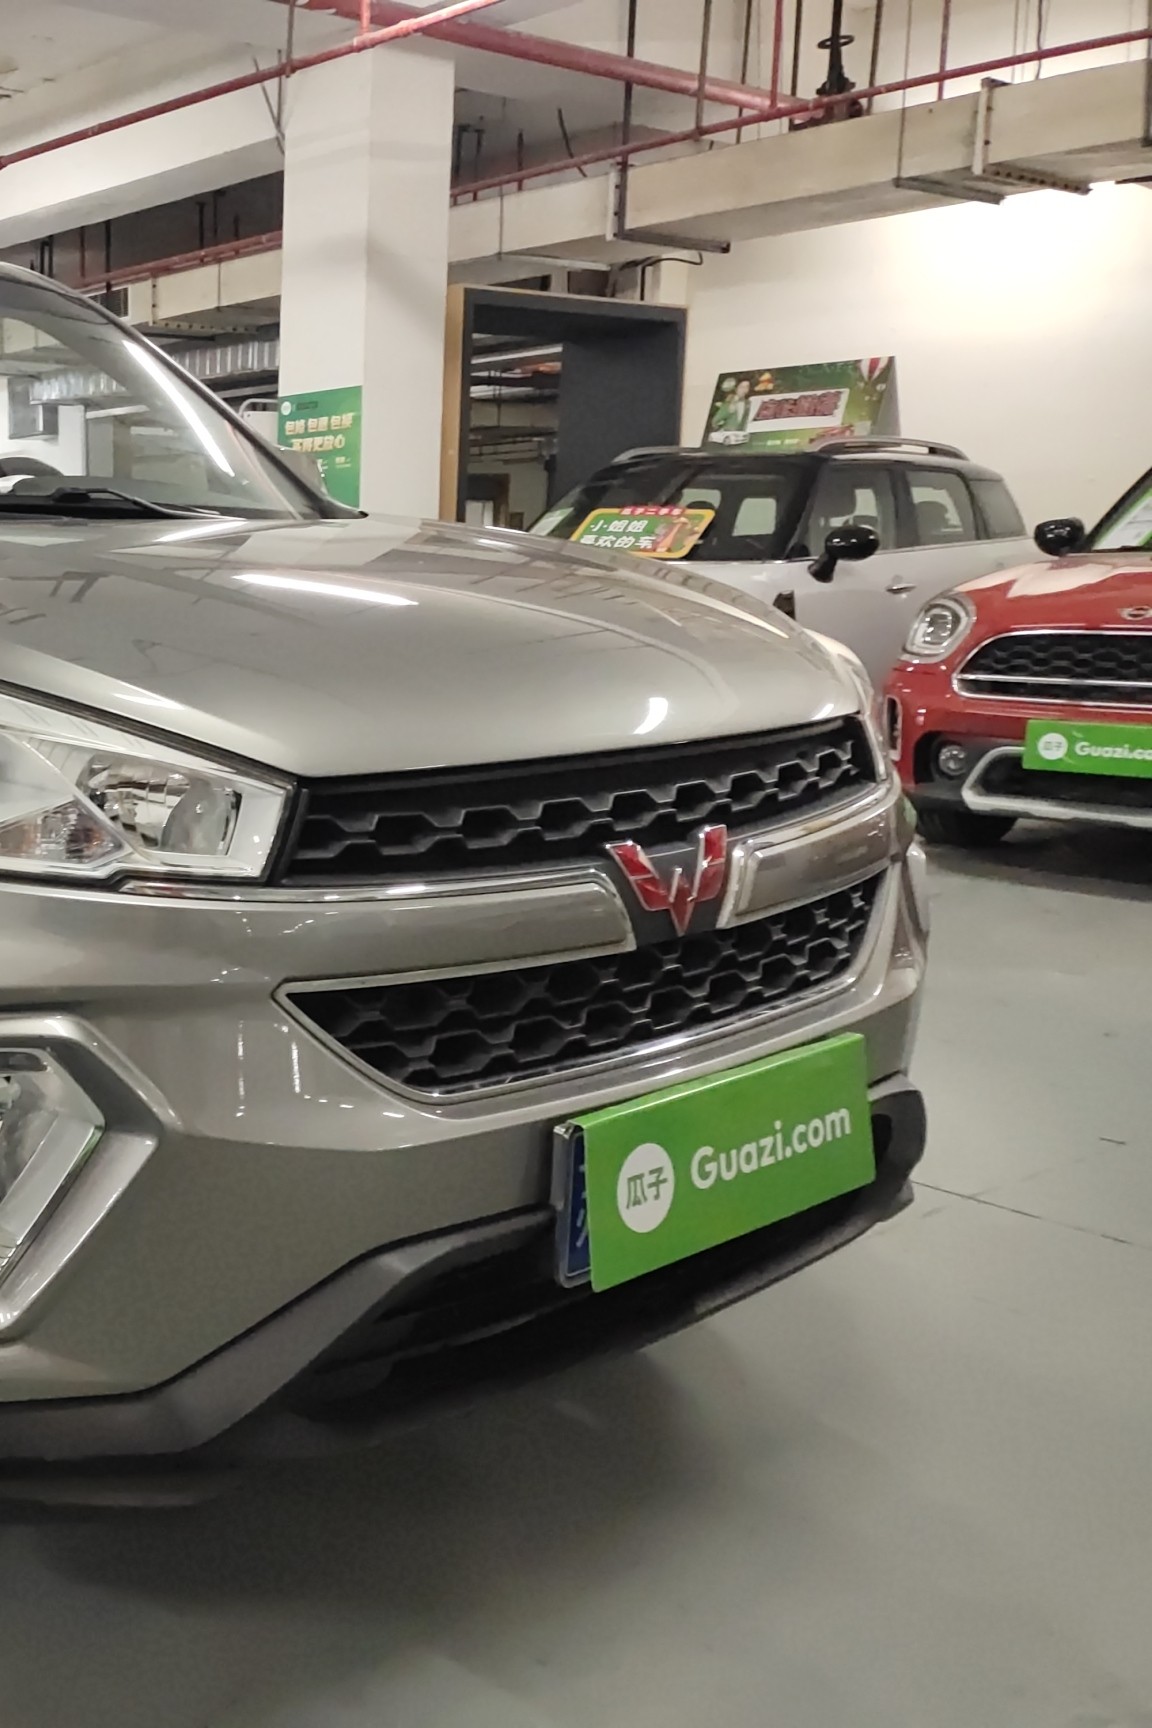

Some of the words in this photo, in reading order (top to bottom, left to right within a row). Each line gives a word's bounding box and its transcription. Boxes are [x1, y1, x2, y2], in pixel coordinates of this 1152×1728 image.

[590, 519, 649, 533] 小姐姐
[580, 534, 656, 549] 喜欢的车
[690, 1107, 852, 1190] Guazi.com
[626, 1166, 668, 1210] 瓜子
